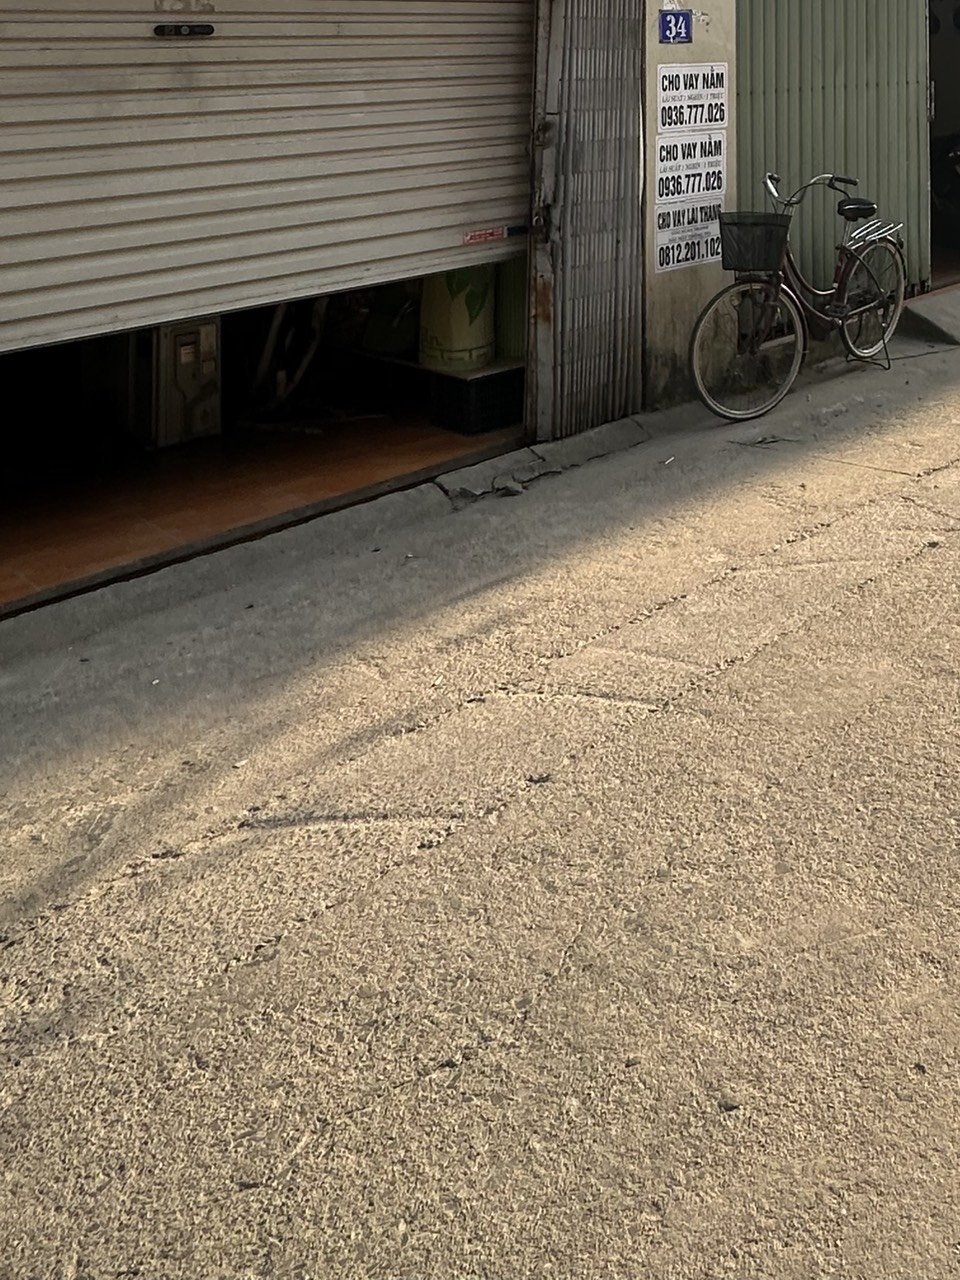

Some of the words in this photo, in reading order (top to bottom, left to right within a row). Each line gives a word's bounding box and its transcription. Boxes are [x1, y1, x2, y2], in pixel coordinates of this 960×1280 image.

[665, 14, 687, 38] 34
[661, 74, 681, 92] CHO
[683, 73, 700, 91] VAY
[661, 103, 725, 127] 0936.777.026
[659, 144, 678, 163] CHO
[681, 142, 698, 160] VAY
[658, 170, 723, 198] 0936.777.026
[657, 211, 671, 230] CHO
[672, 209, 686, 227] VAY
[658, 236, 721, 268] 0812.201.102
